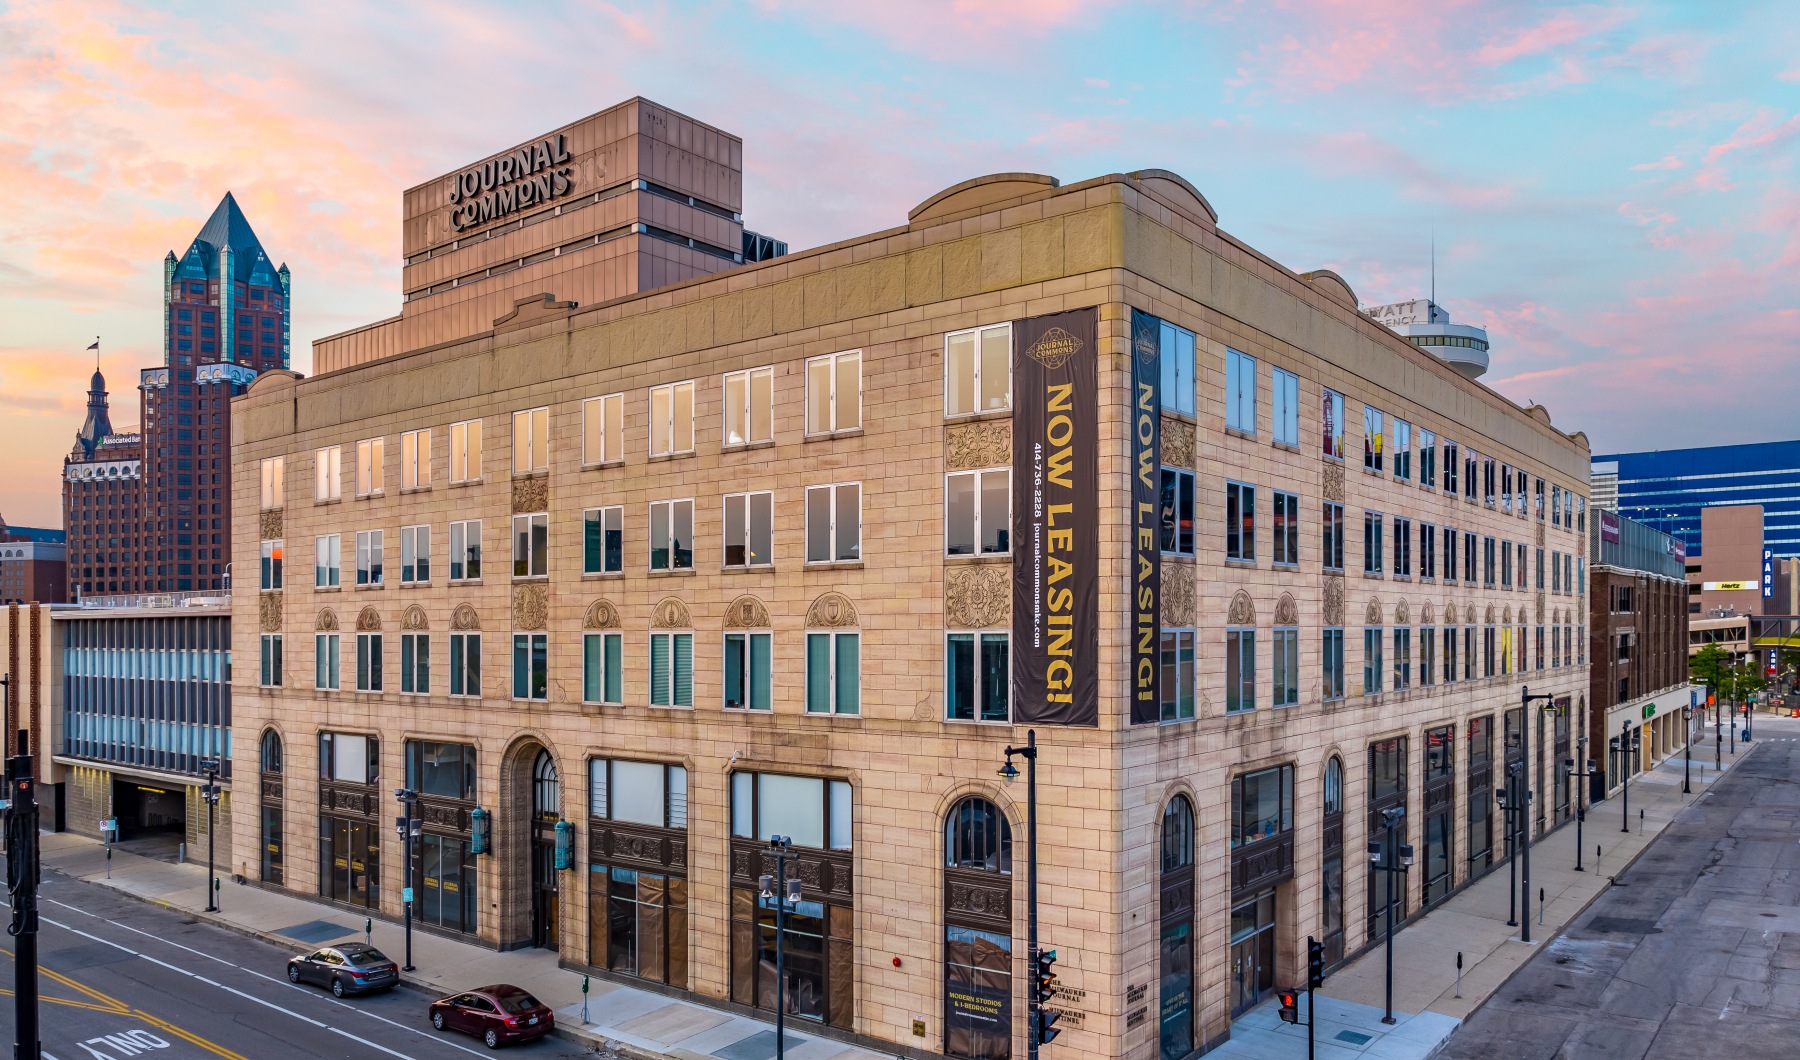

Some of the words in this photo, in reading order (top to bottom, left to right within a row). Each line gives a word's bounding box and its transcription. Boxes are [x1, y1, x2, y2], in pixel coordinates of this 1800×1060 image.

[450, 134, 571, 204] JOURNAL
[450, 167, 573, 232] COMMONS
[1036, 339, 1073, 351] JOURNAL
[1036, 345, 1073, 358] COMMONS
[103, 436, 131, 444] Associated
[1047, 382, 1073, 489] NOW
[1138, 382, 1153, 489] NOW
[1033, 523, 1041, 648] journalcommonsmke.com
[1046, 503, 1073, 704] LEASING!
[1138, 502, 1153, 701] LEASING!
[949, 992, 975, 1002] MODERN
[975, 997, 1002, 1007] STUDIOS
[1053, 993, 1080, 1002] OURNAL
[1058, 1016, 1079, 1024] TINEL
[75, 1029, 170, 1060] ONLY
